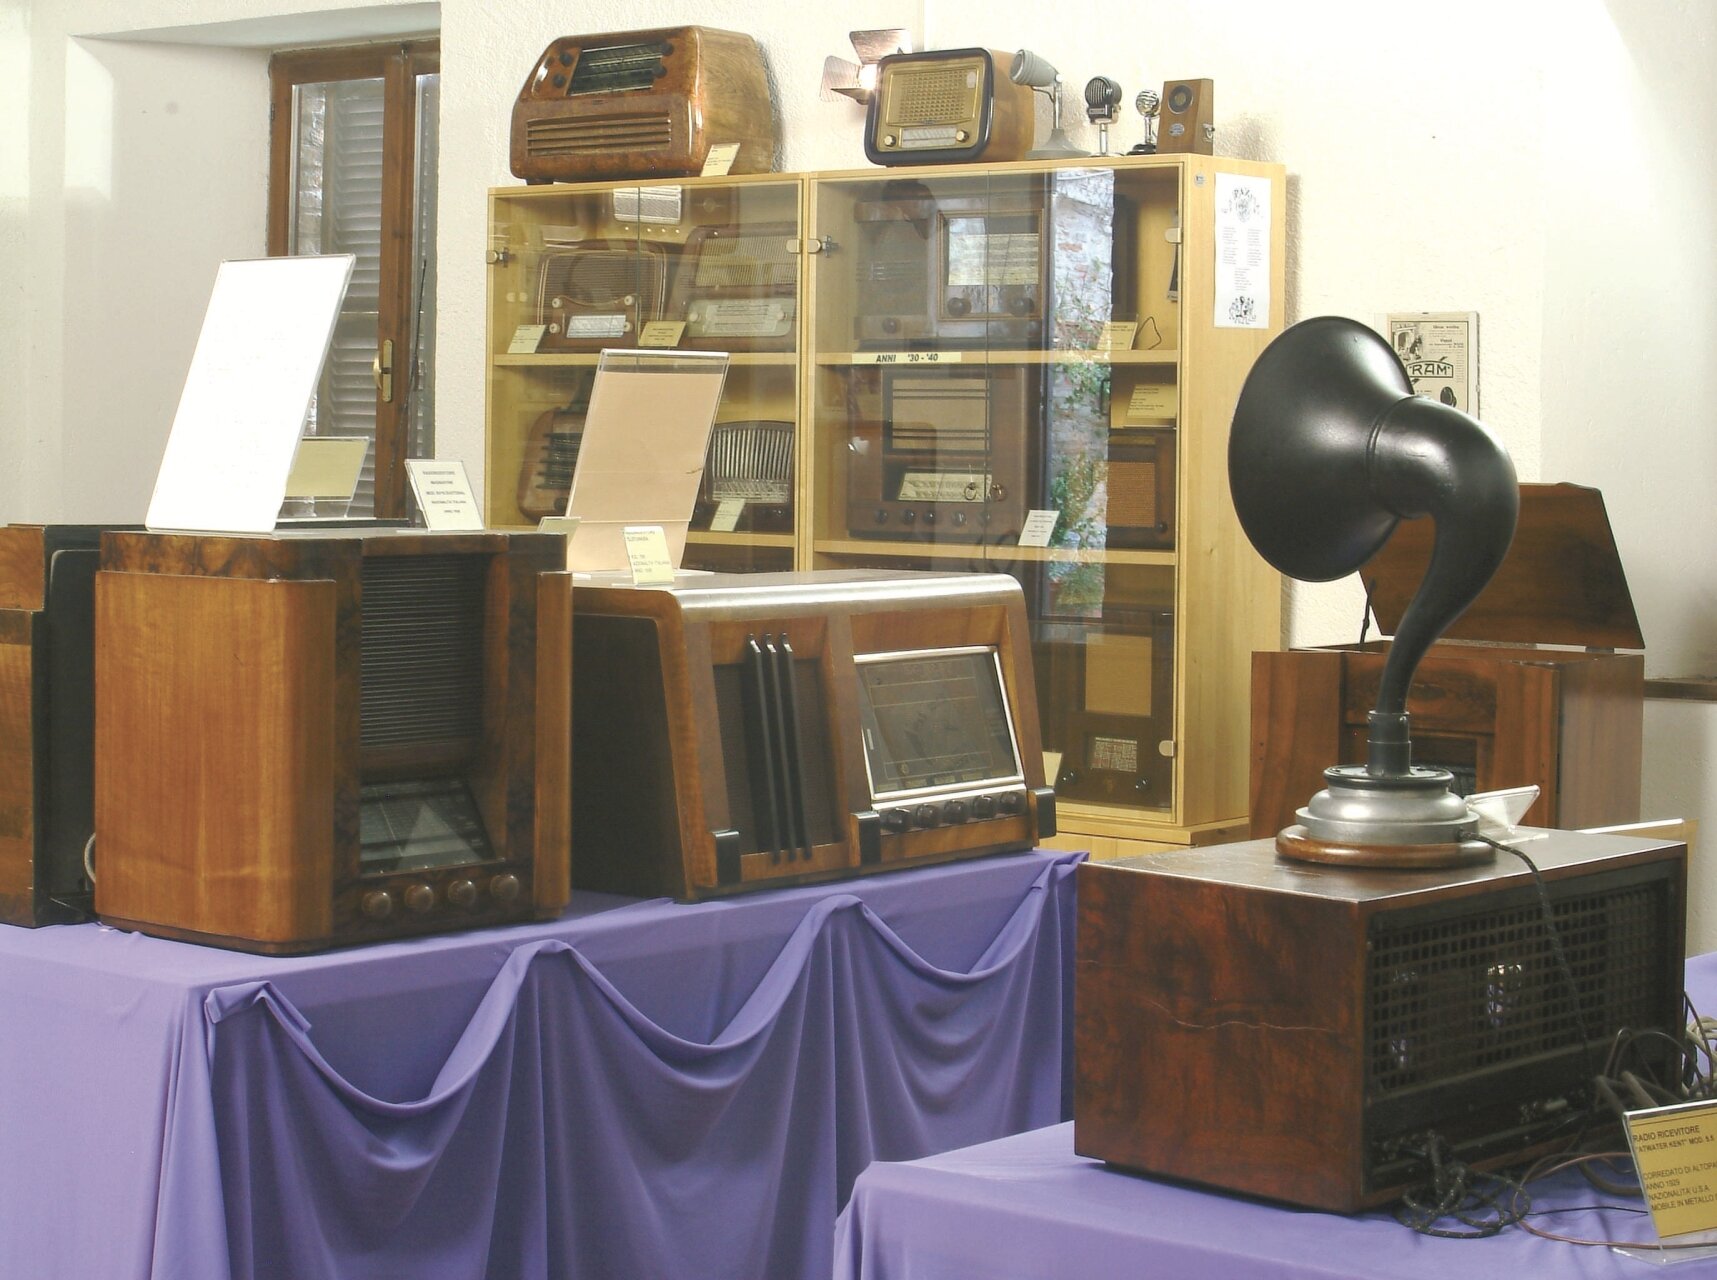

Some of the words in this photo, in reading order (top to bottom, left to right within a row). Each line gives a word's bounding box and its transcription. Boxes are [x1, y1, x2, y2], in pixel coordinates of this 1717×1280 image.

[876, 354, 897, 363] ANNI
[1632, 1132, 1656, 1142] RADIO
[1657, 1125, 1700, 1138] RICEVITORE
[1645, 1181, 1665, 1190] ANNO
